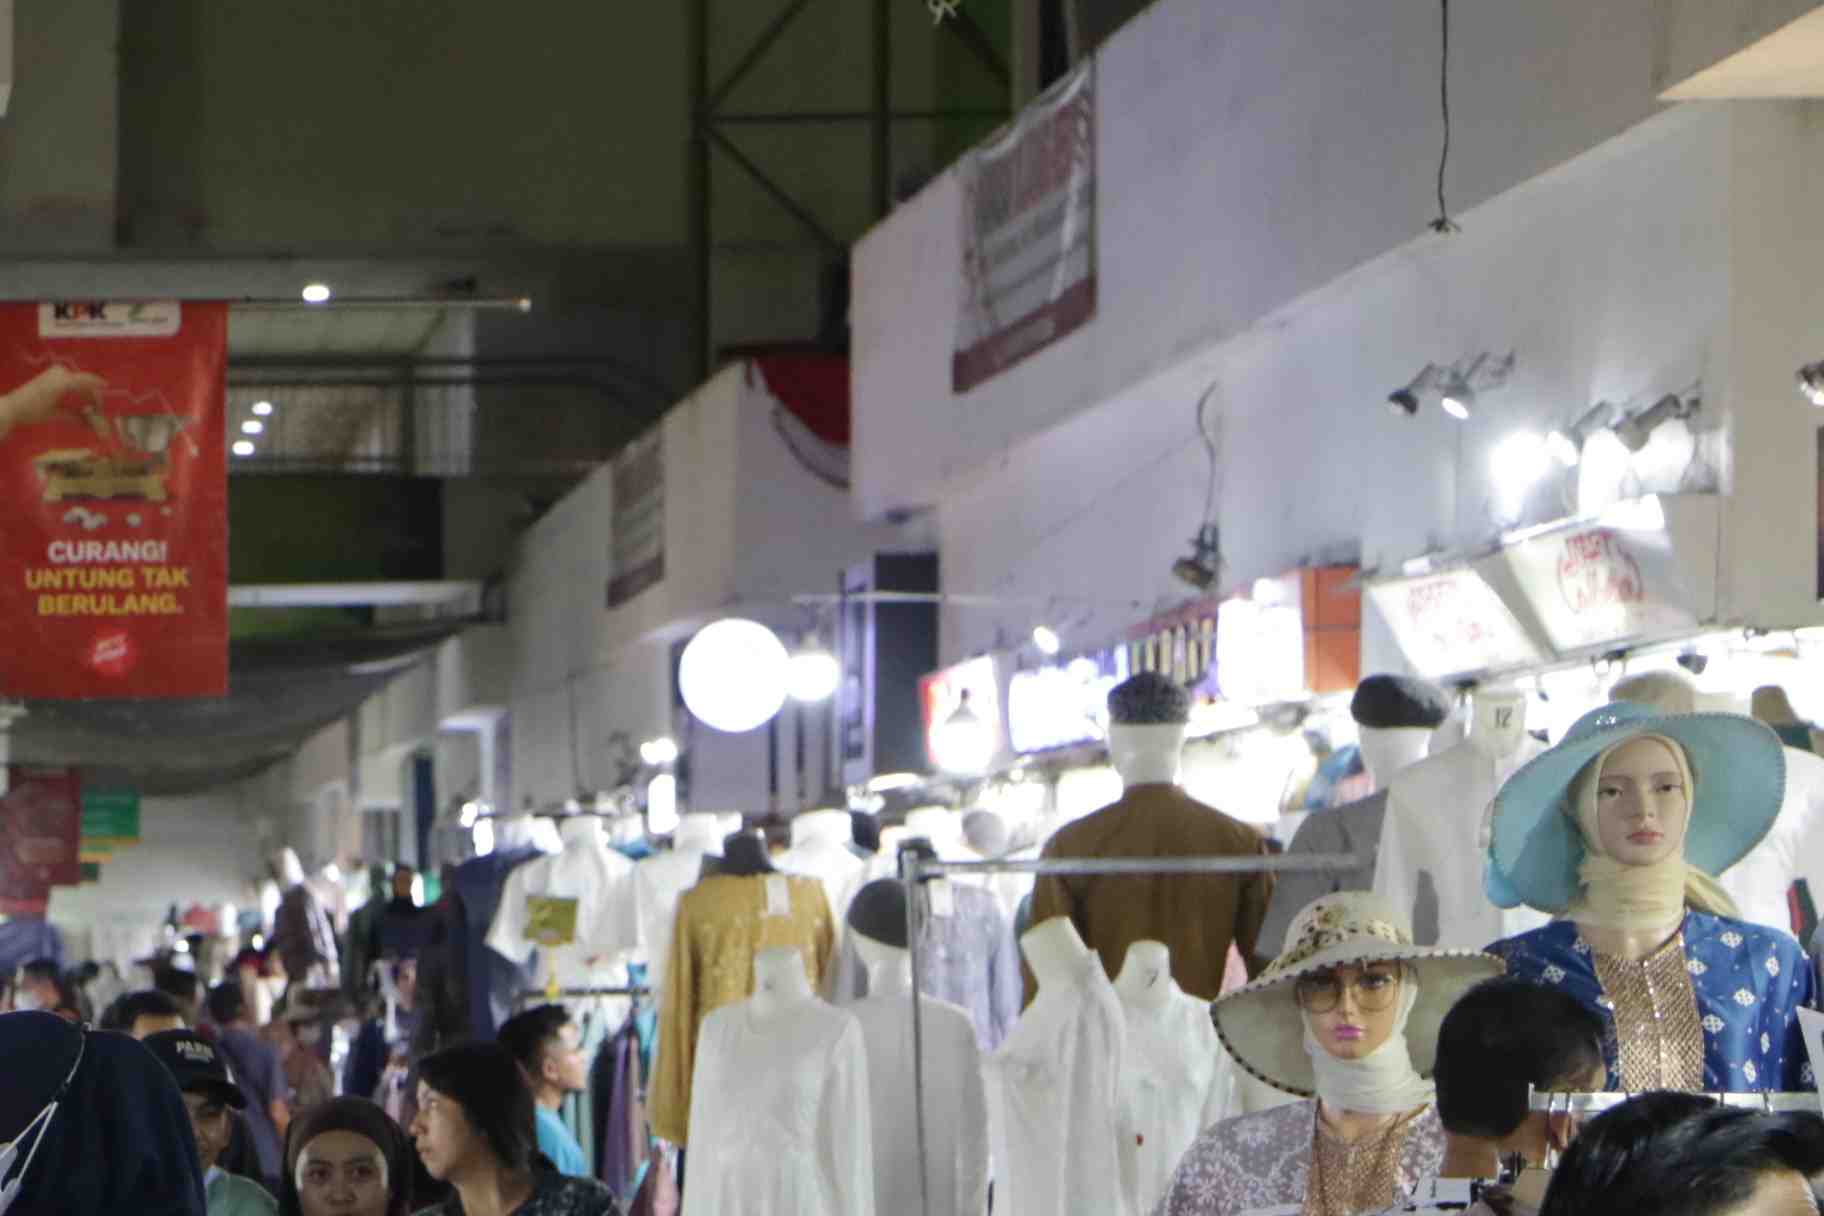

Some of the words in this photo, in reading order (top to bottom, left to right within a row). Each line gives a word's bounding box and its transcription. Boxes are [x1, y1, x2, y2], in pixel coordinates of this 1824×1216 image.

[26, 567, 134, 589] UNTUNG
[143, 567, 190, 587] TAK
[37, 594, 185, 616] BERULANG.
